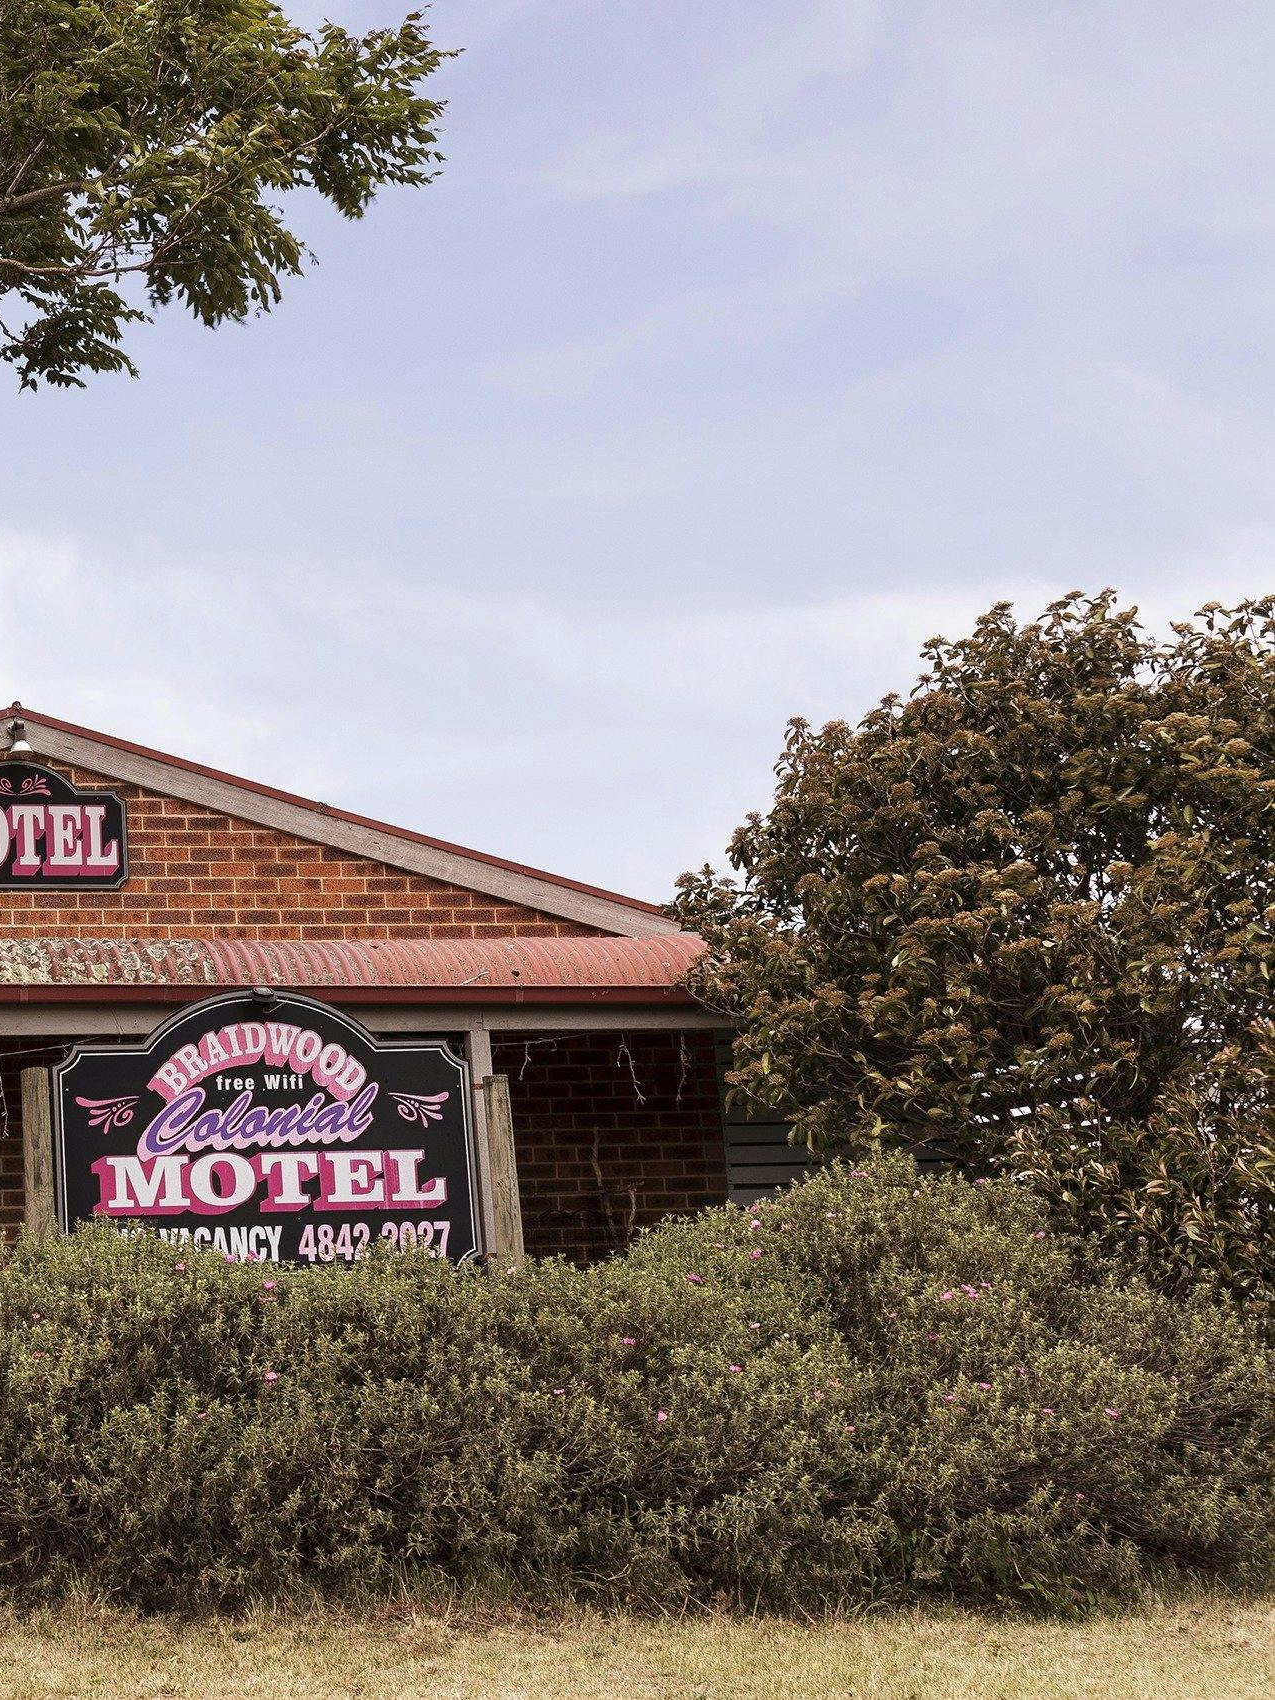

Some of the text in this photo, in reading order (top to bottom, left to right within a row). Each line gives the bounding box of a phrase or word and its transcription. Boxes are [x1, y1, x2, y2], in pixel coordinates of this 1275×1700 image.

[147, 1021, 368, 1102] BRAIDWOOD
[216, 1074, 304, 1091] free Wifi
[137, 1083, 379, 1162] Colonial
[91, 1149, 448, 1216] MOTEL
[298, 1222, 370, 1262] 4842
